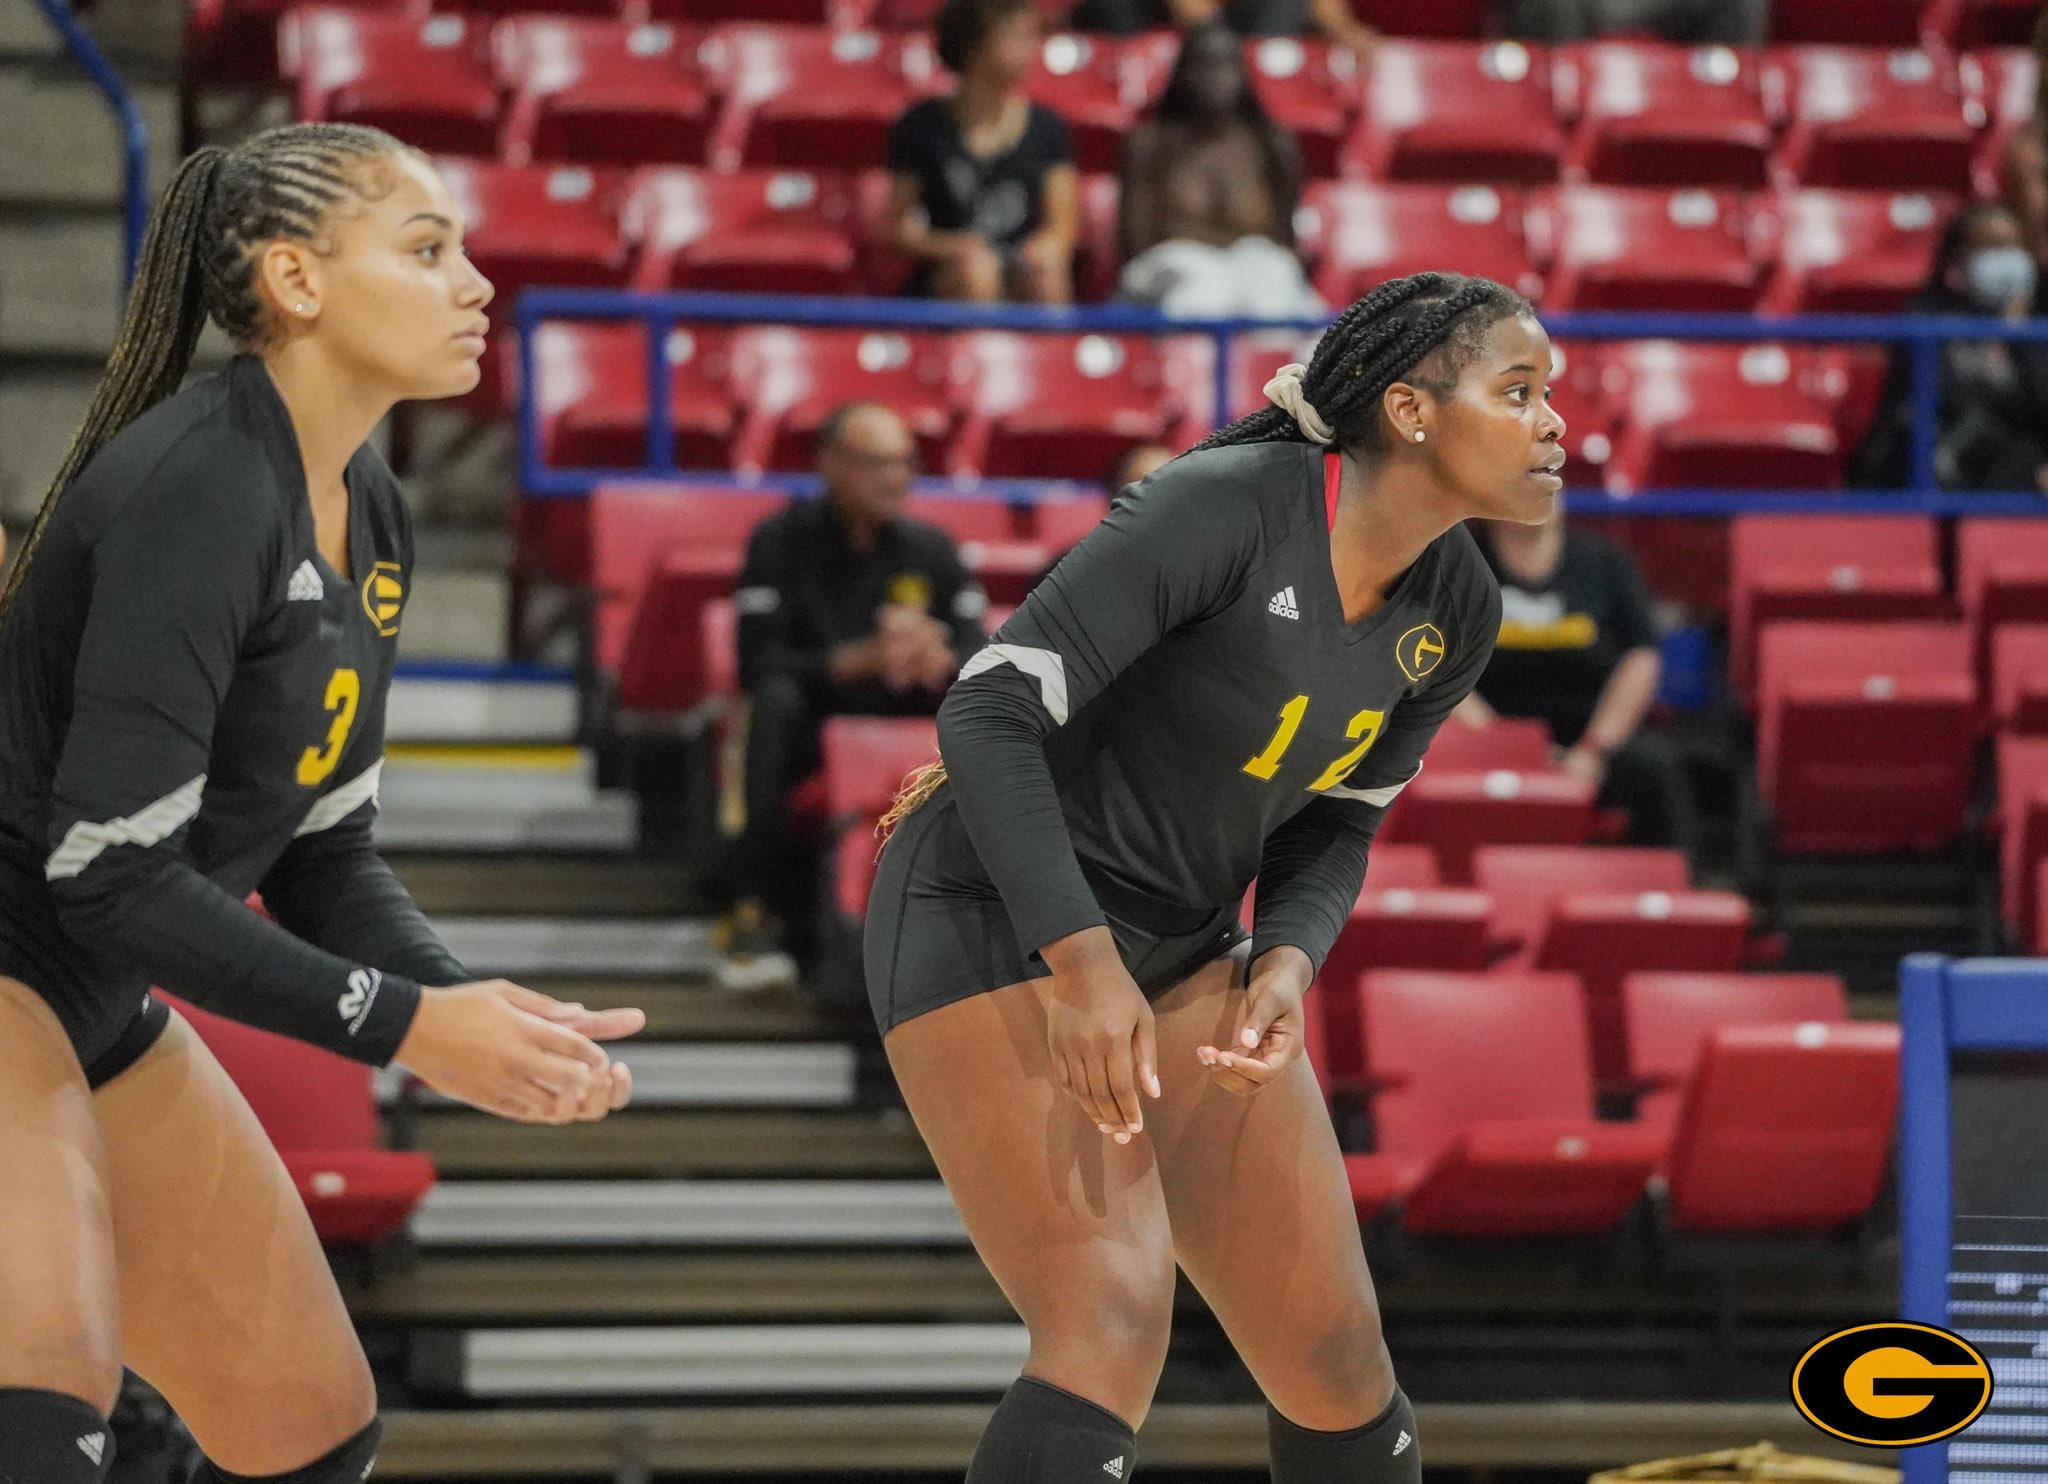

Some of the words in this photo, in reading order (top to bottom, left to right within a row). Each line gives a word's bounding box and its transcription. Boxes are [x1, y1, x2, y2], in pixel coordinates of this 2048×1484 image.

[1268, 602, 1300, 620] adidas
[297, 668, 360, 785] 3
[1242, 694, 1385, 791] 12
